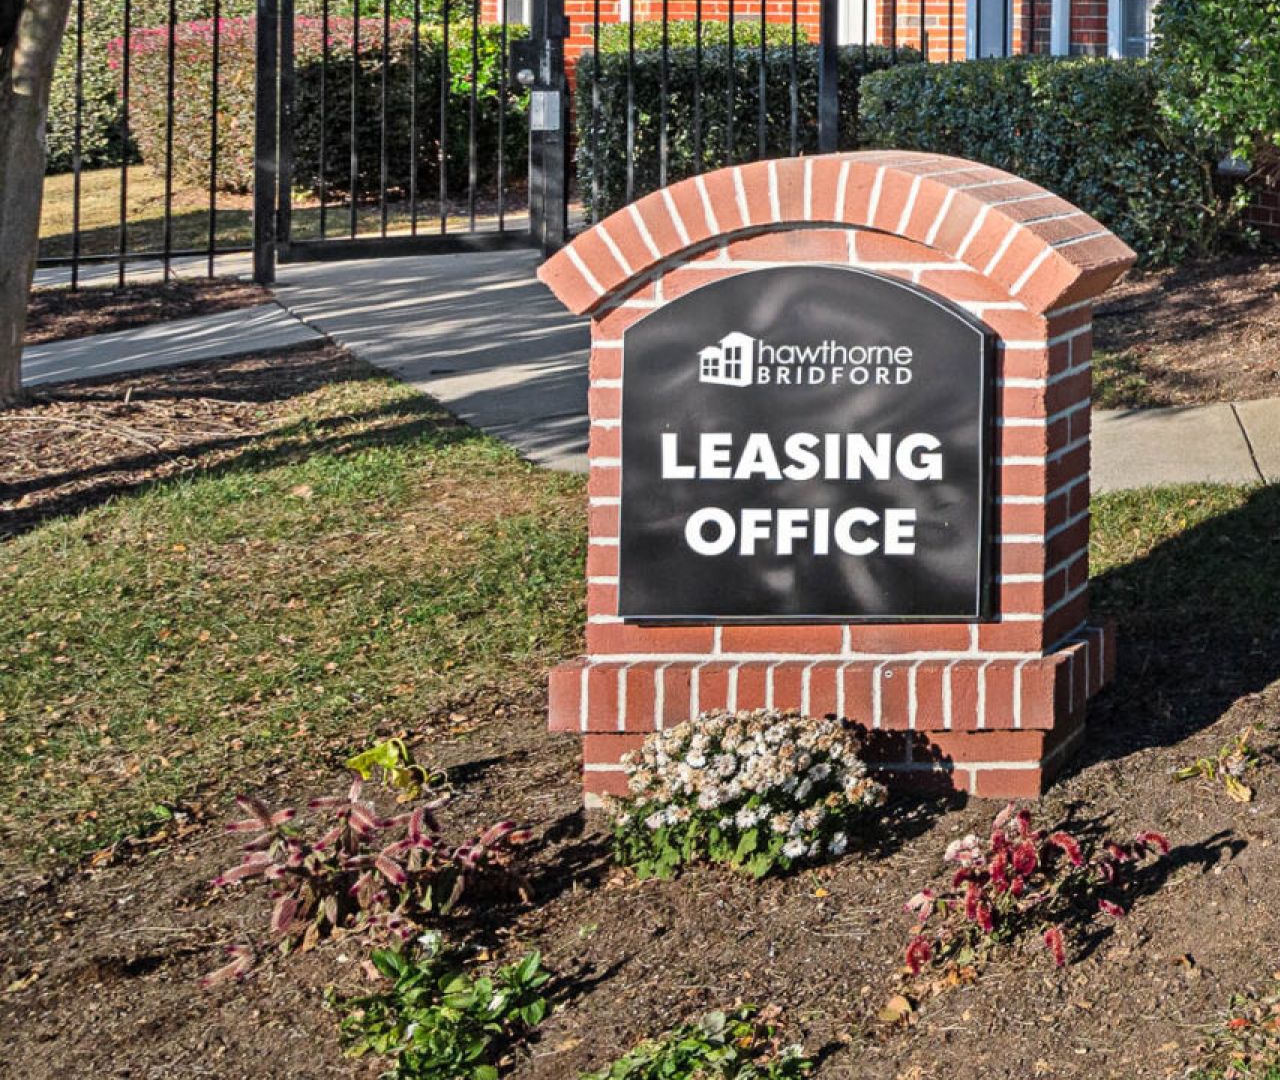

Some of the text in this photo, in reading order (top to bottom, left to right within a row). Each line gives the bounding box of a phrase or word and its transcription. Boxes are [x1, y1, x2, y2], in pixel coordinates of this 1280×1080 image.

[757, 339, 913, 365] hawthorne
[757, 366, 913, 385] BRIDFORD
[661, 432, 943, 481] LEASING
[684, 506, 918, 556] OFFICE
